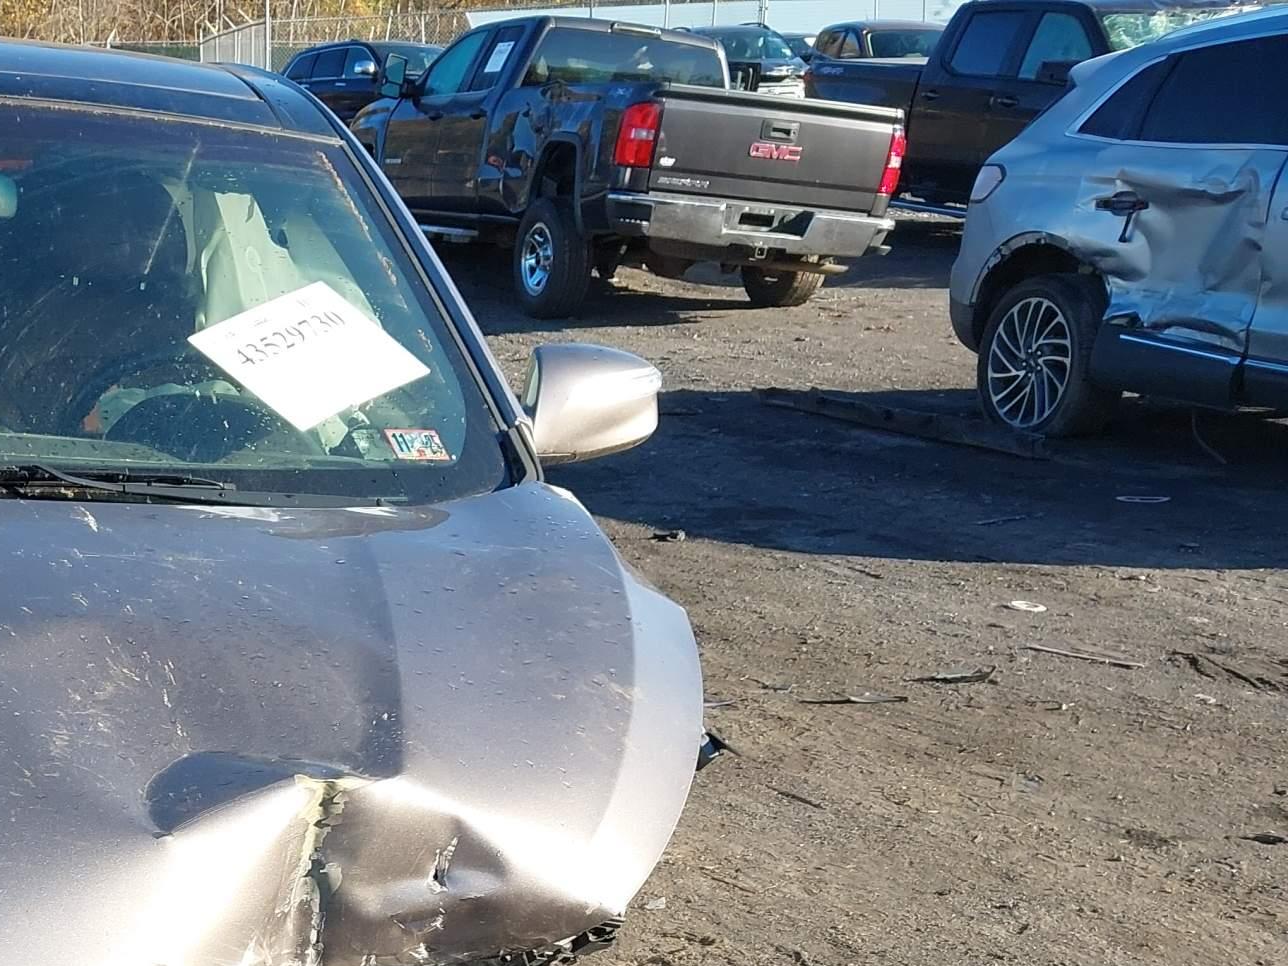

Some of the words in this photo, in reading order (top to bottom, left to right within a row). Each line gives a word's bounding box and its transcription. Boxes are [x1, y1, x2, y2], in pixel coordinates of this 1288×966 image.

[749, 143, 803, 160] GMC
[237, 311, 346, 365] 43529730
[392, 433, 411, 453] 11
